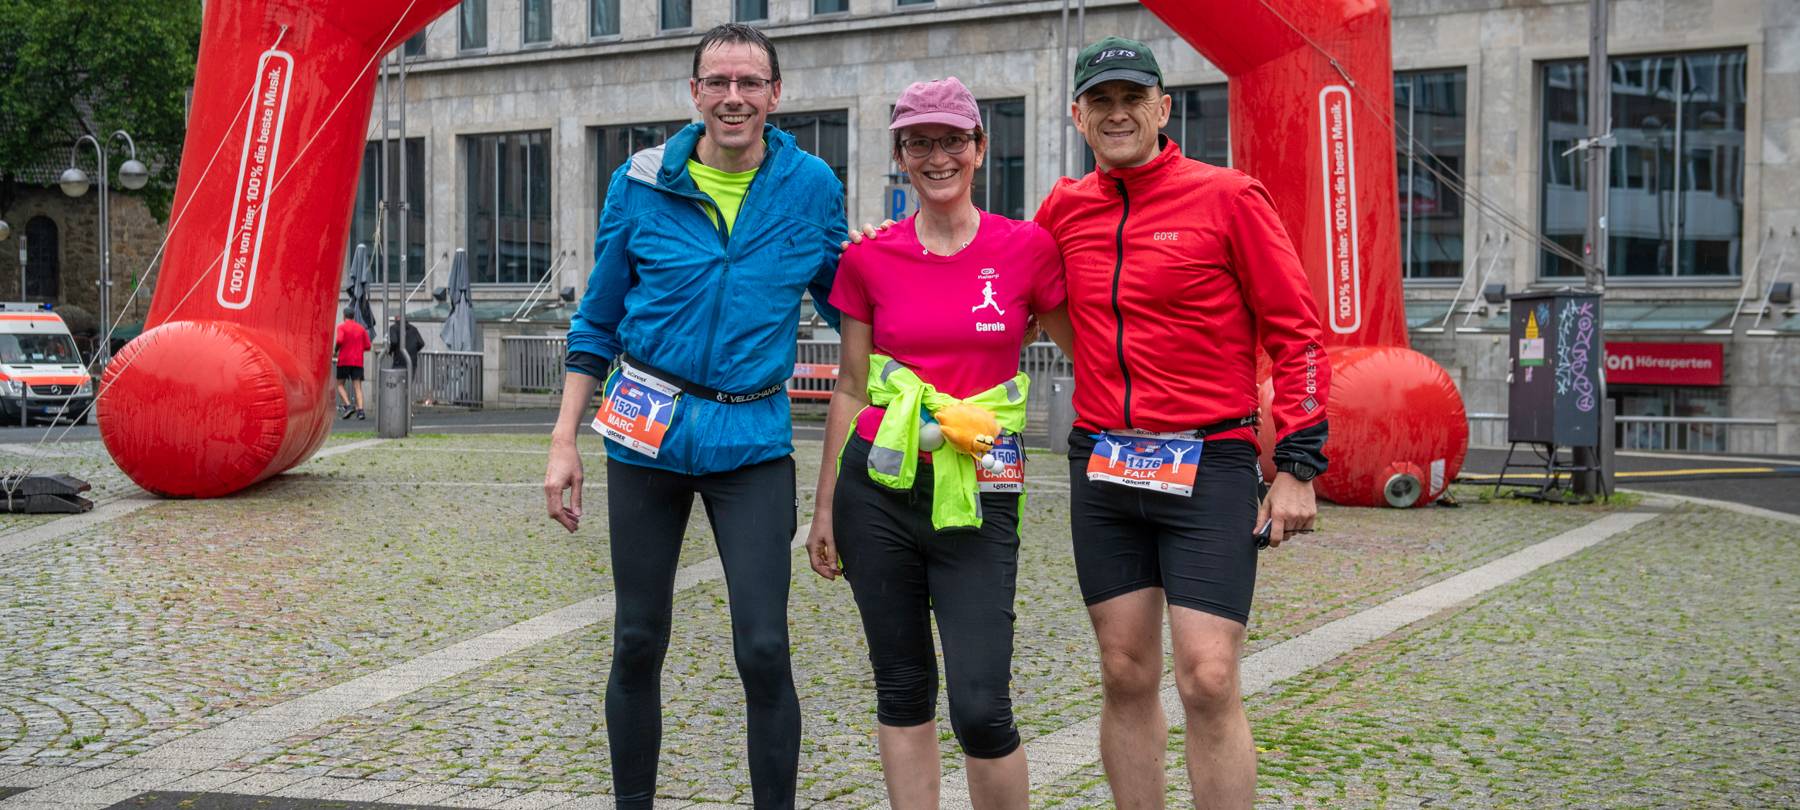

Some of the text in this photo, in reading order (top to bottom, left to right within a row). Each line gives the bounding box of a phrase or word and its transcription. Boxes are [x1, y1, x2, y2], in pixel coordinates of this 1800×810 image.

[1095, 49, 1137, 64] JETS
[229, 66, 282, 294] 100% von hier. 100% die beste Musik.
[1330, 100, 1351, 320] 100% von hier. 100% die beste Musik.
[1153, 231, 1179, 241] GORE
[975, 321, 1006, 332] Carola
[1635, 354, 1712, 371] Hörexperten
[613, 397, 639, 419] 1520
[607, 413, 635, 433] MARC
[991, 450, 1017, 464] 1506
[1127, 456, 1162, 469] 1476
[1123, 469, 1158, 479] FALK
